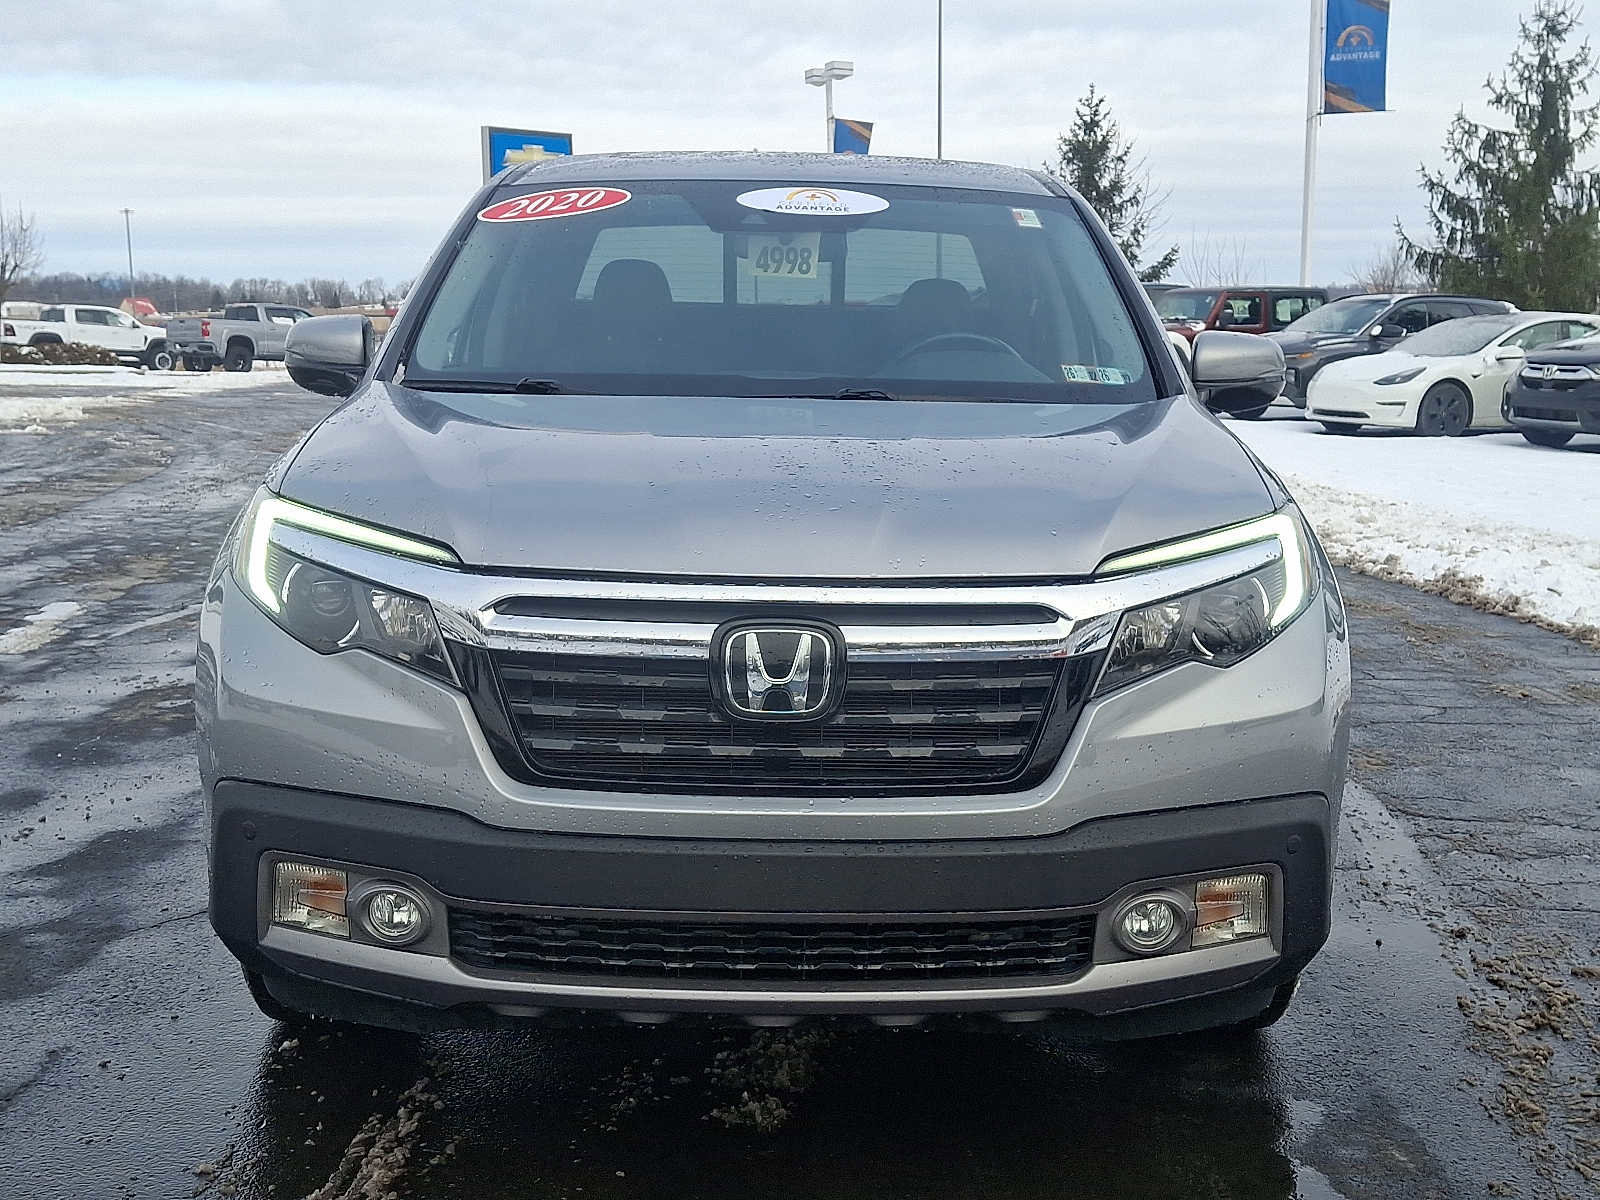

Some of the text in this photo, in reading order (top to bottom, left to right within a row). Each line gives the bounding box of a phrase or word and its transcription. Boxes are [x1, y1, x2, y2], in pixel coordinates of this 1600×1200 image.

[1330, 51, 1381, 61] ADVANTAGE
[497, 190, 606, 218] 2020
[776, 204, 849, 212] ADVANTAGE
[755, 246, 812, 275] 4998
